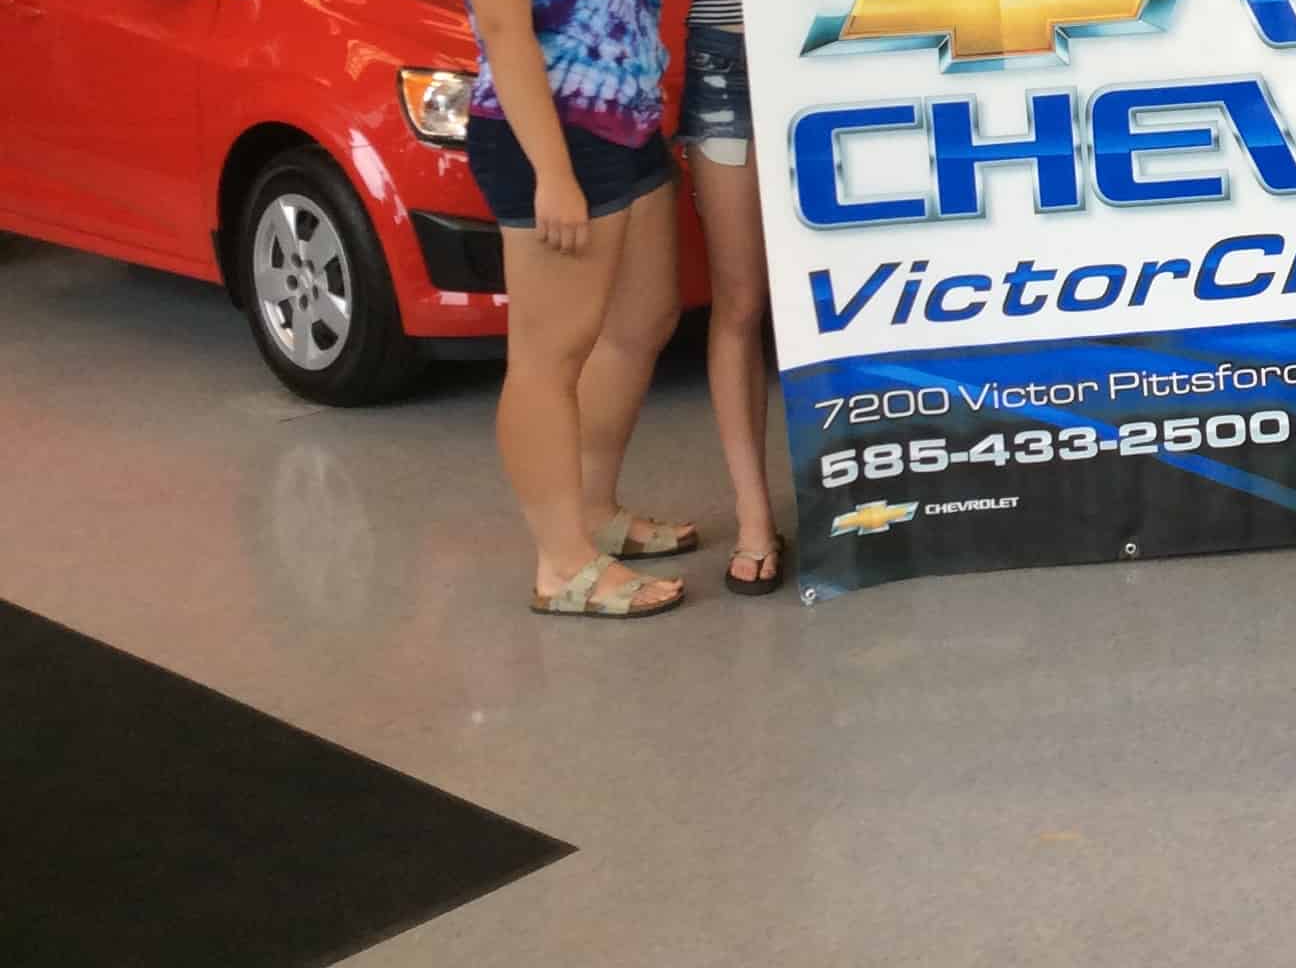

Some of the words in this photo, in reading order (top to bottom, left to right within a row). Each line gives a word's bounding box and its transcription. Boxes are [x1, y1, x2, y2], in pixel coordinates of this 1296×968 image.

[814, 387, 950, 429] 7200
[958, 380, 1098, 412] Victor
[820, 409, 1290, 488] 585-433-2500
[925, 497, 1019, 514] CHEVROLET
